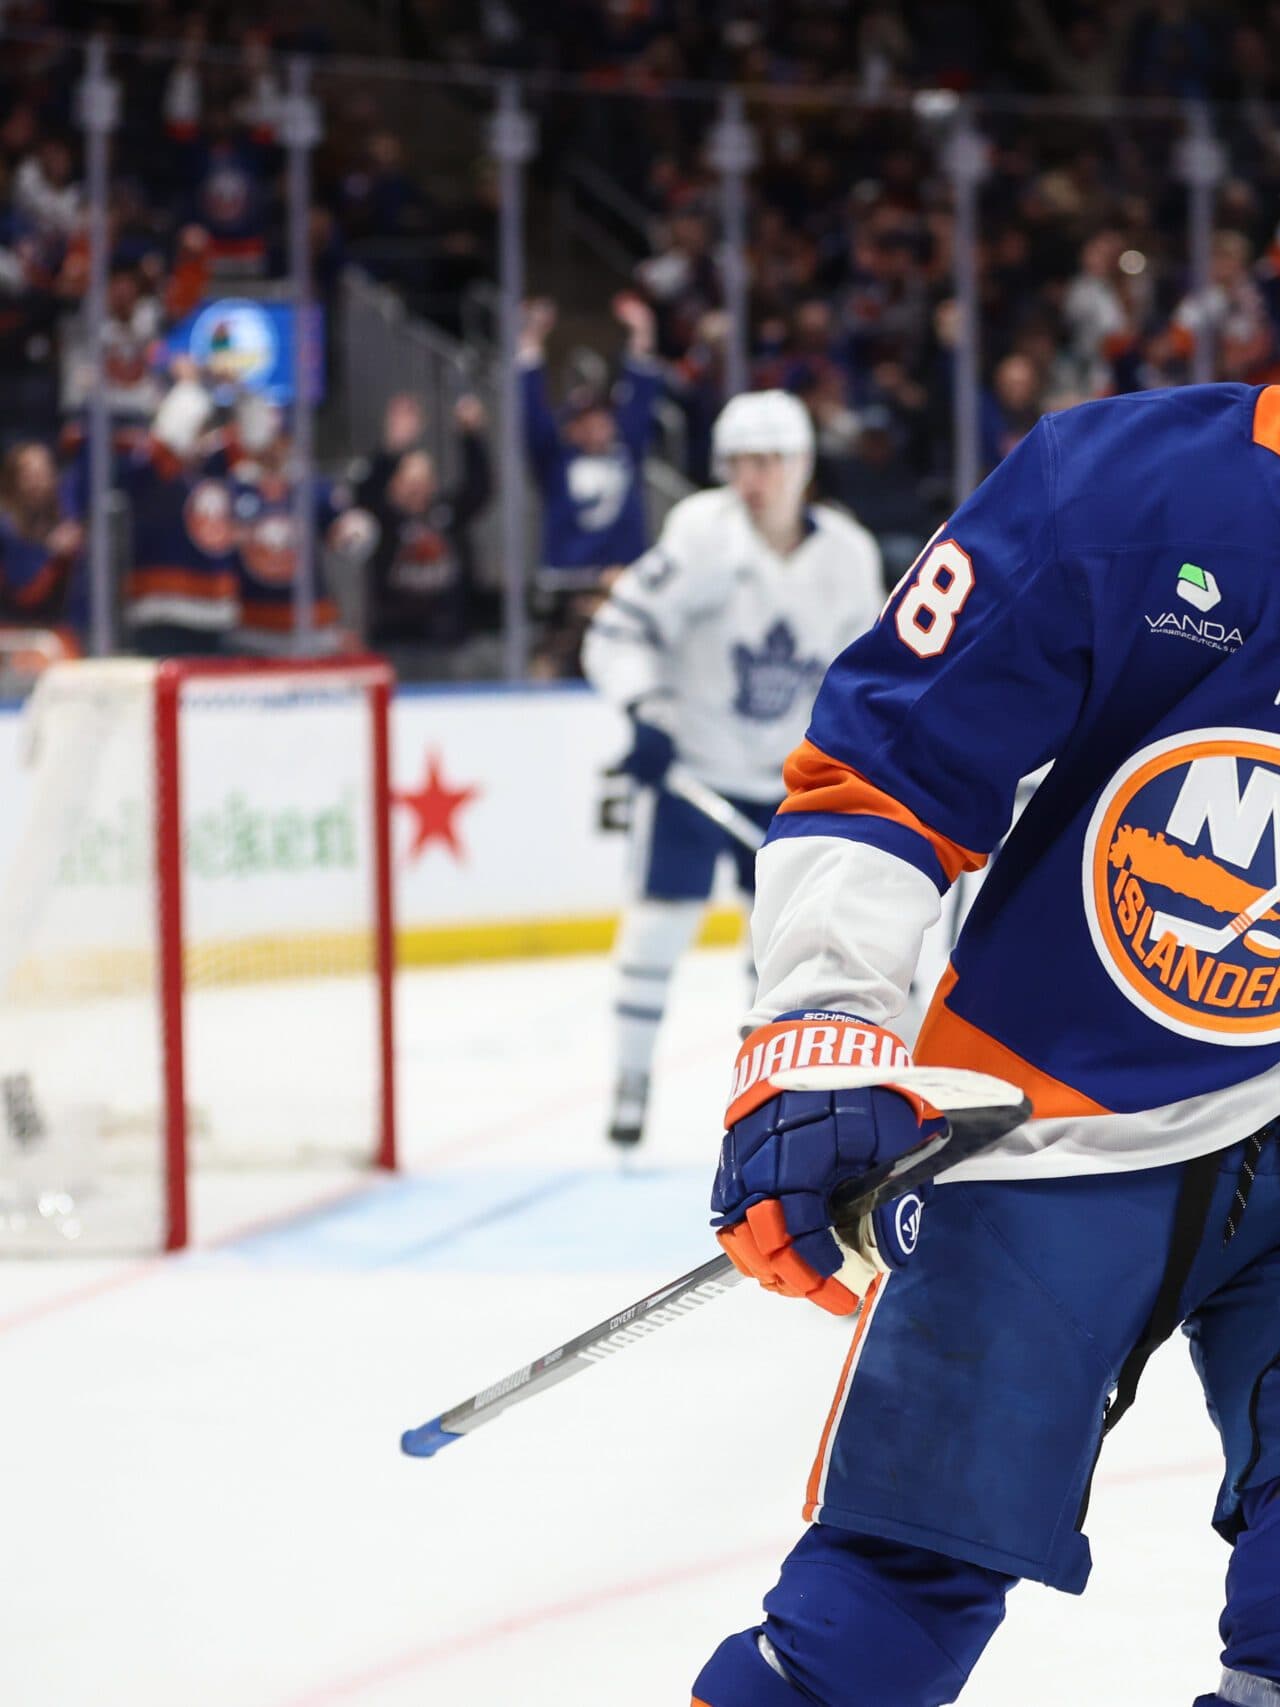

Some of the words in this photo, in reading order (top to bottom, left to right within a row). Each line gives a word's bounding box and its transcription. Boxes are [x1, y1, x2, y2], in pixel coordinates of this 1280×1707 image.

[880, 522, 976, 659] 8
[1144, 612, 1243, 646] VANDA
[609, 1307, 636, 1331] COVERT
